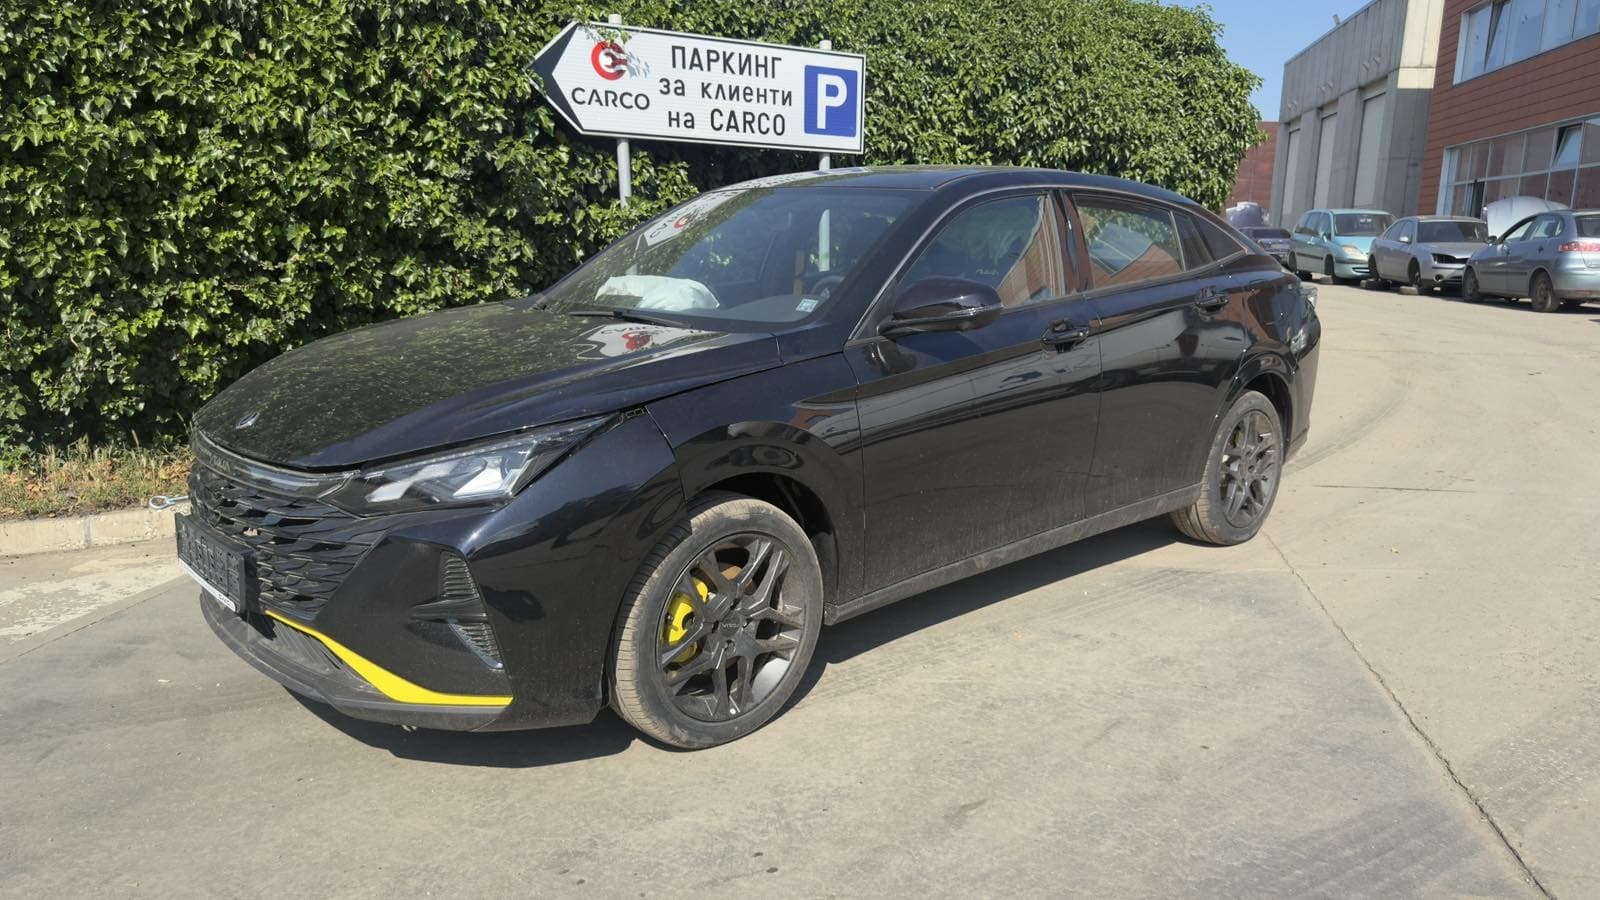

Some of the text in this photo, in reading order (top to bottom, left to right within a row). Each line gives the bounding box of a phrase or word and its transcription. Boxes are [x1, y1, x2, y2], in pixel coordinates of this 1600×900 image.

[671, 46, 782, 78] ПАРКИНГ
[571, 88, 650, 110] CARCO
[659, 78, 793, 106] за клиенти
[816, 73, 847, 129] P
[668, 109, 785, 136] на CARCO
